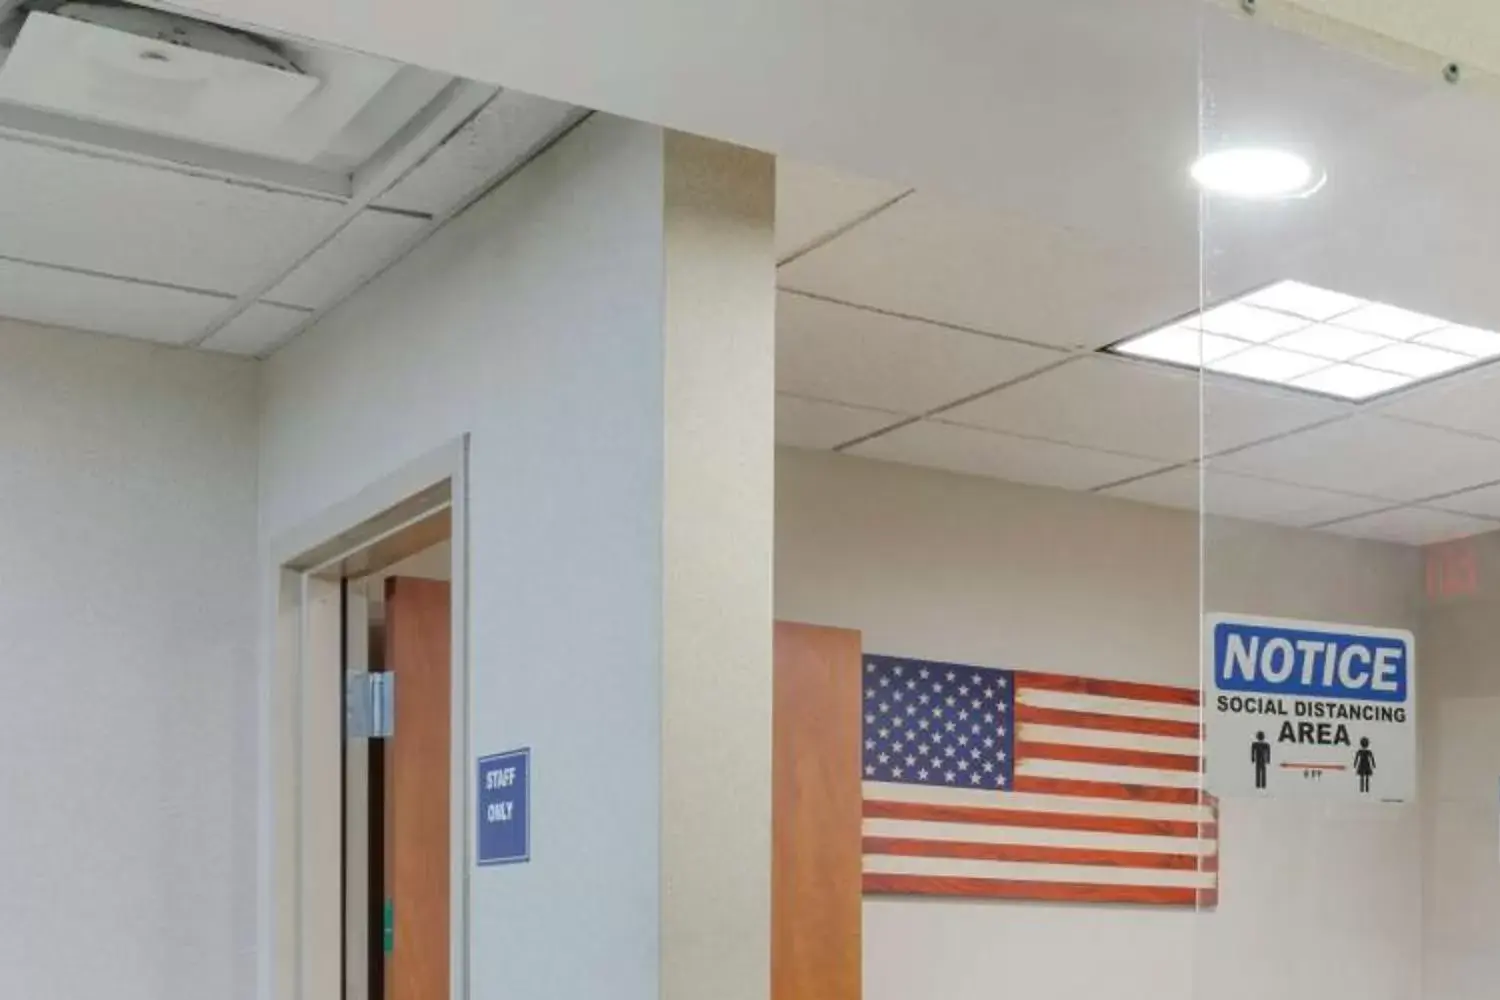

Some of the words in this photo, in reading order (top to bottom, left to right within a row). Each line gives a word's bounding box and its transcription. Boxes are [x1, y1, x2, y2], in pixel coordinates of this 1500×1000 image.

[1222, 633, 1402, 692] NOTICE
[1217, 695, 1288, 716] SOCIAL
[1294, 701, 1407, 723] DISTANCING
[1278, 721, 1350, 746] AREA
[486, 767, 516, 789] STAFF
[487, 801, 513, 823] ONLY
